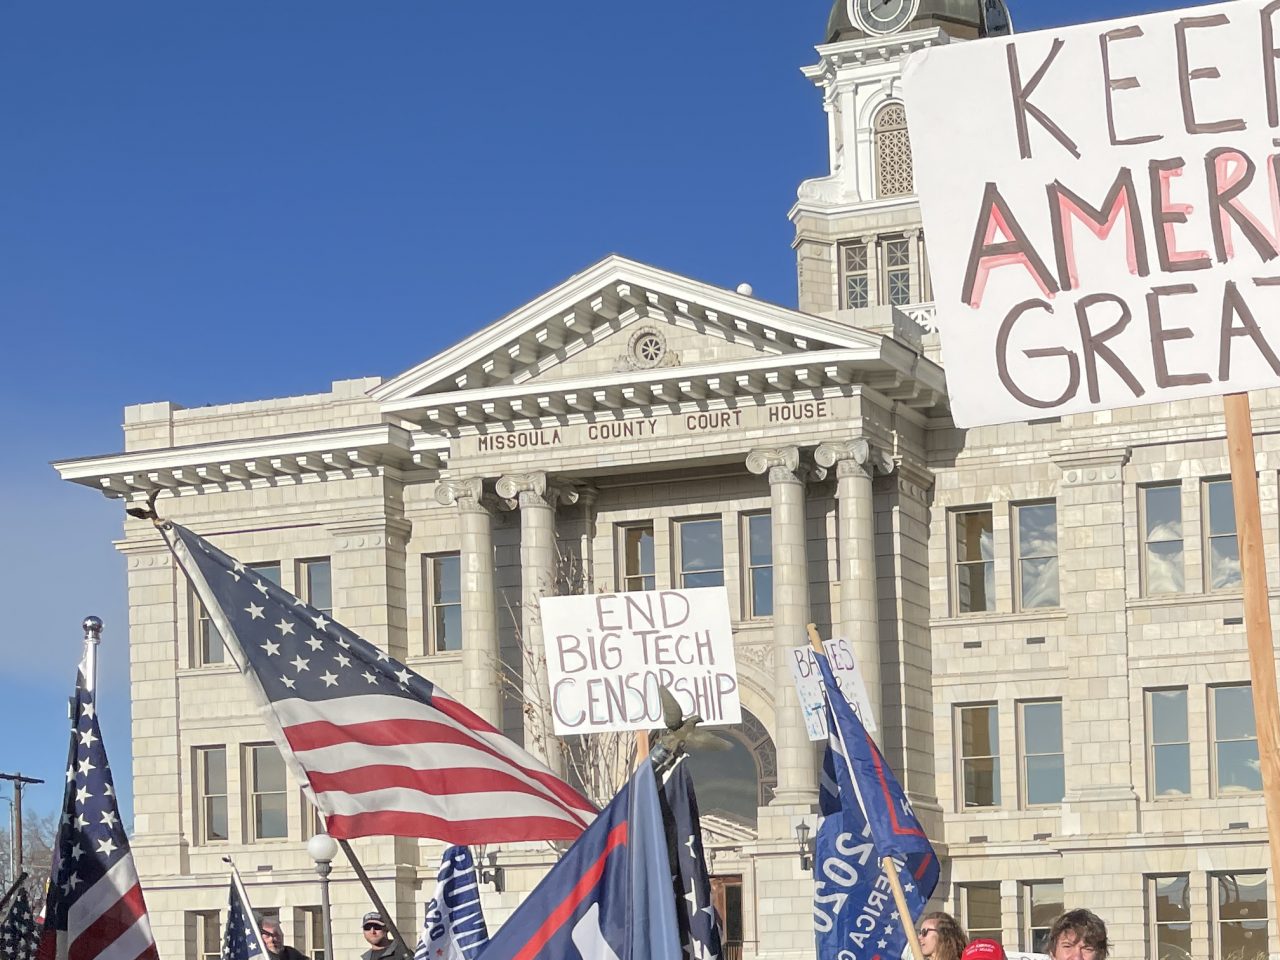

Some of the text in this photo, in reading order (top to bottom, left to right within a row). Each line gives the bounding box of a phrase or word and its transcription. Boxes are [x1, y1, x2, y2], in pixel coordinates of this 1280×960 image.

[478, 430, 562, 452] MISSOULA
[588, 418, 658, 441] COUNTY
[686, 409, 743, 431] COURT
[596, 591, 690, 631] END
[633, 629, 715, 666] TECH
